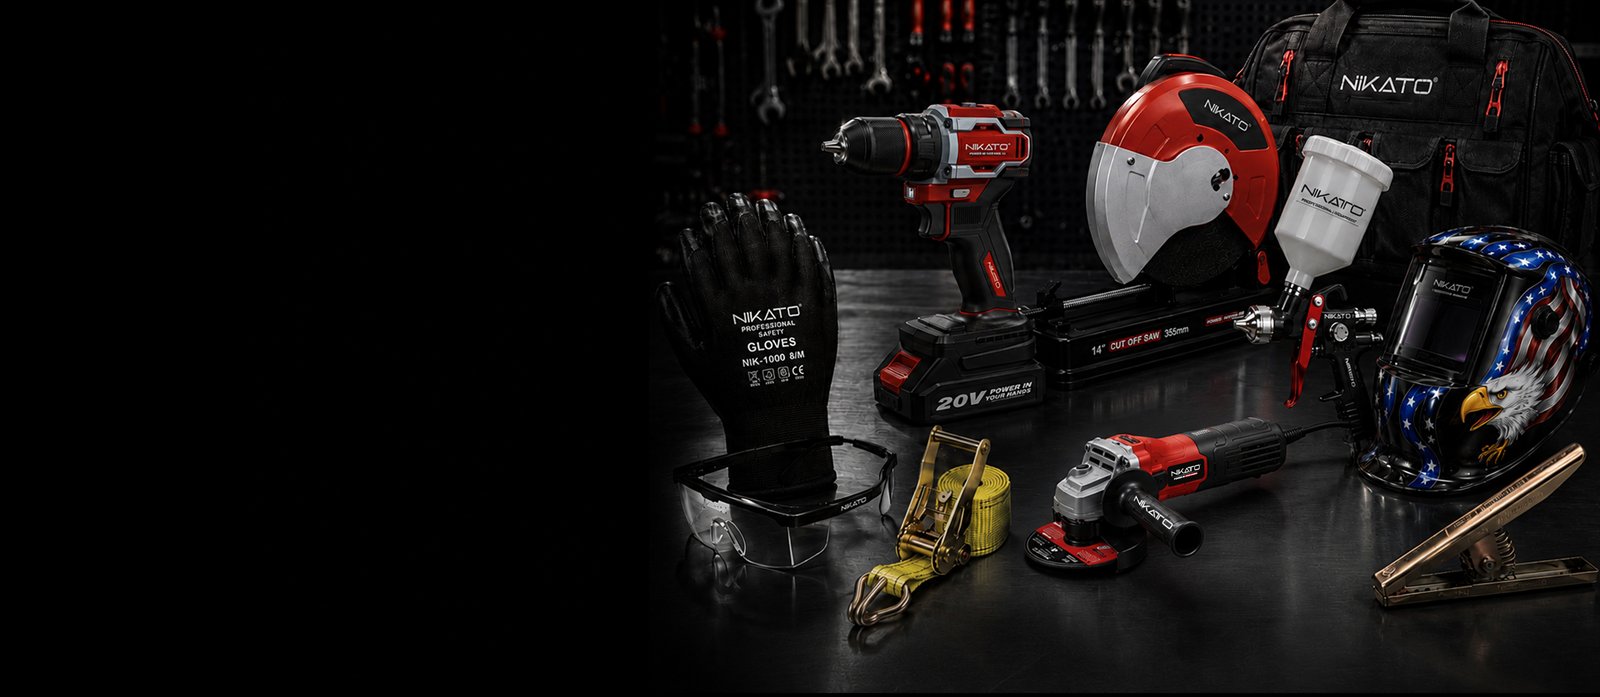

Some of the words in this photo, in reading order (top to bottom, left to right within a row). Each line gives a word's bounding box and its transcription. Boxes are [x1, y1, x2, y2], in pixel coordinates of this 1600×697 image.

[1203, 99, 1249, 132] NIKATO
[965, 142, 1009, 151] NIKATO
[1433, 279, 1471, 294] NIKATO
[732, 305, 800, 325] NIKATO
[741, 320, 796, 332] PROFESSIONAL
[758, 328, 785, 338] SAFETY
[747, 337, 797, 352] GLOVES
[1110, 340, 1126, 350] CUT
[1127, 335, 1143, 346] OFF
[1143, 331, 1160, 342] SAW
[1163, 326, 1189, 338] 355mm
[742, 353, 786, 367] NIK-1000
[789, 350, 805, 360] 8/M
[990, 385, 1021, 395] POWER
[1022, 381, 1033, 389] IN
[936, 390, 987, 411] 20V
[1171, 464, 1201, 477] NIKATO
[840, 496, 867, 511] NIKATO
[1133, 495, 1173, 530] NIKATO
